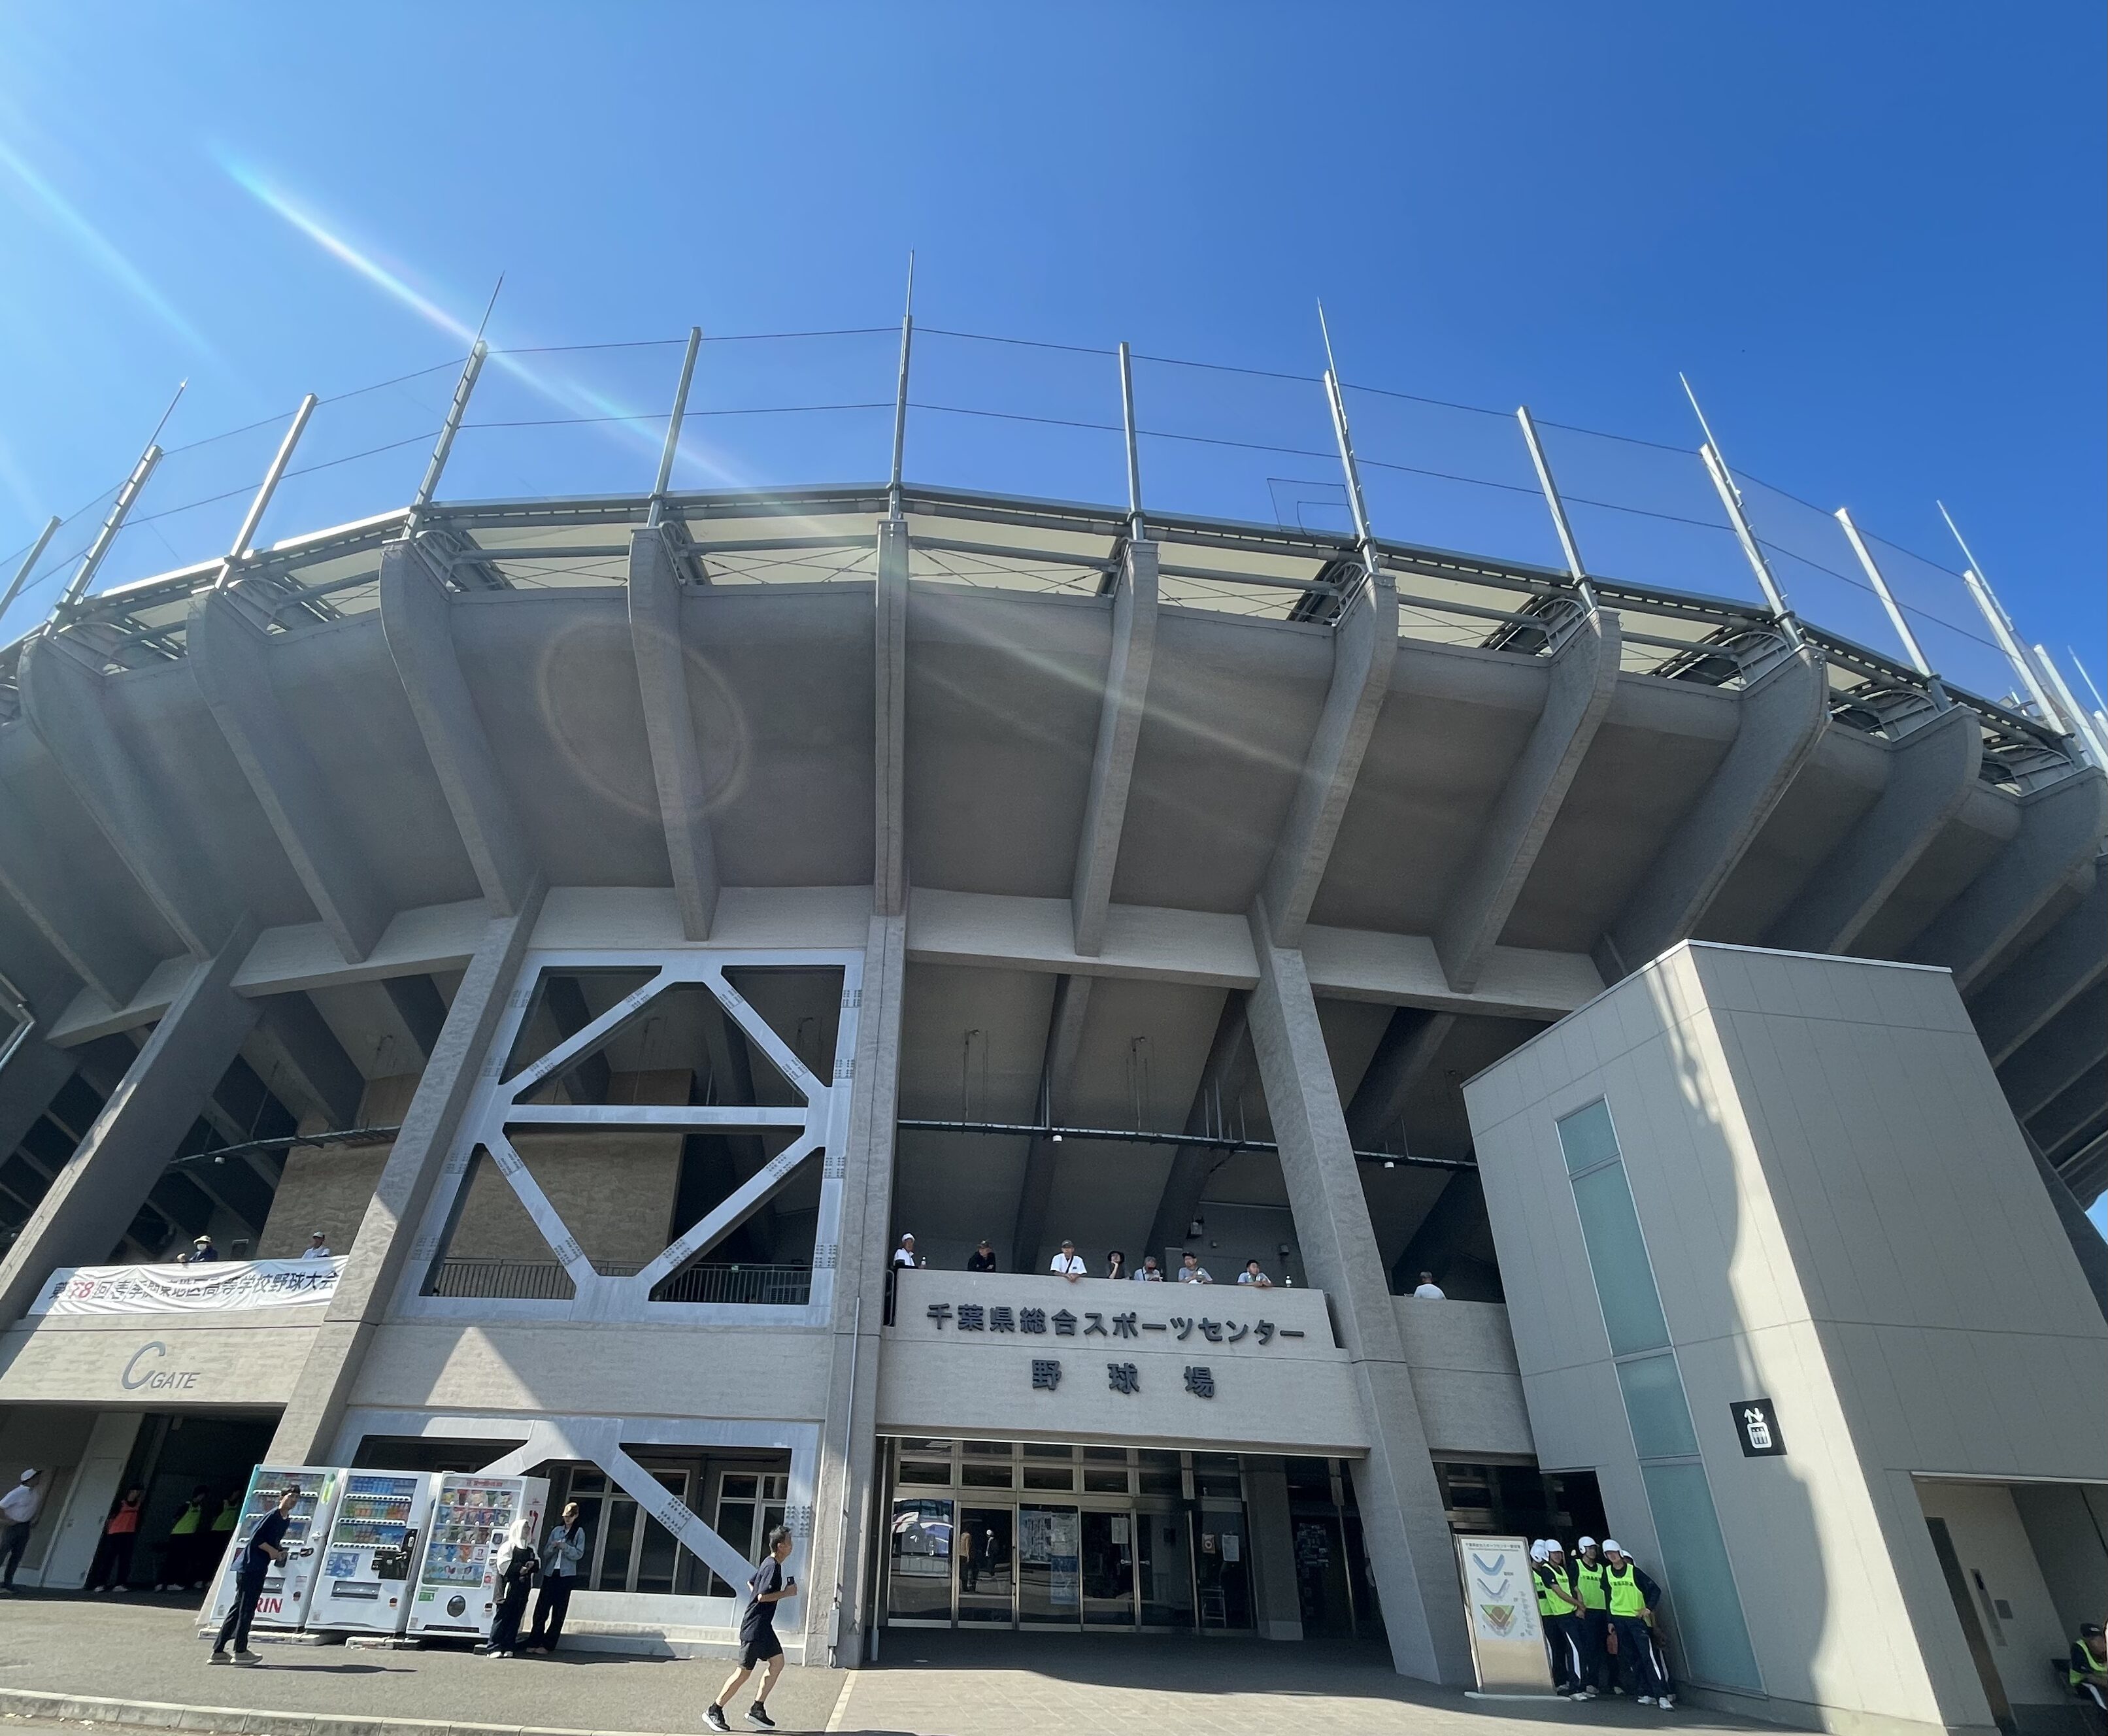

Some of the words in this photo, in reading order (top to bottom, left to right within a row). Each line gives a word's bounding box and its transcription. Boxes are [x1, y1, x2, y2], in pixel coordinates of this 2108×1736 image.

[927, 1303, 1305, 1345] 千葉県総合スポーツセンター
[122, 1341, 166, 1390] C
[150, 1371, 201, 1389] GATE
[1031, 1360, 1215, 1398] 野球場
